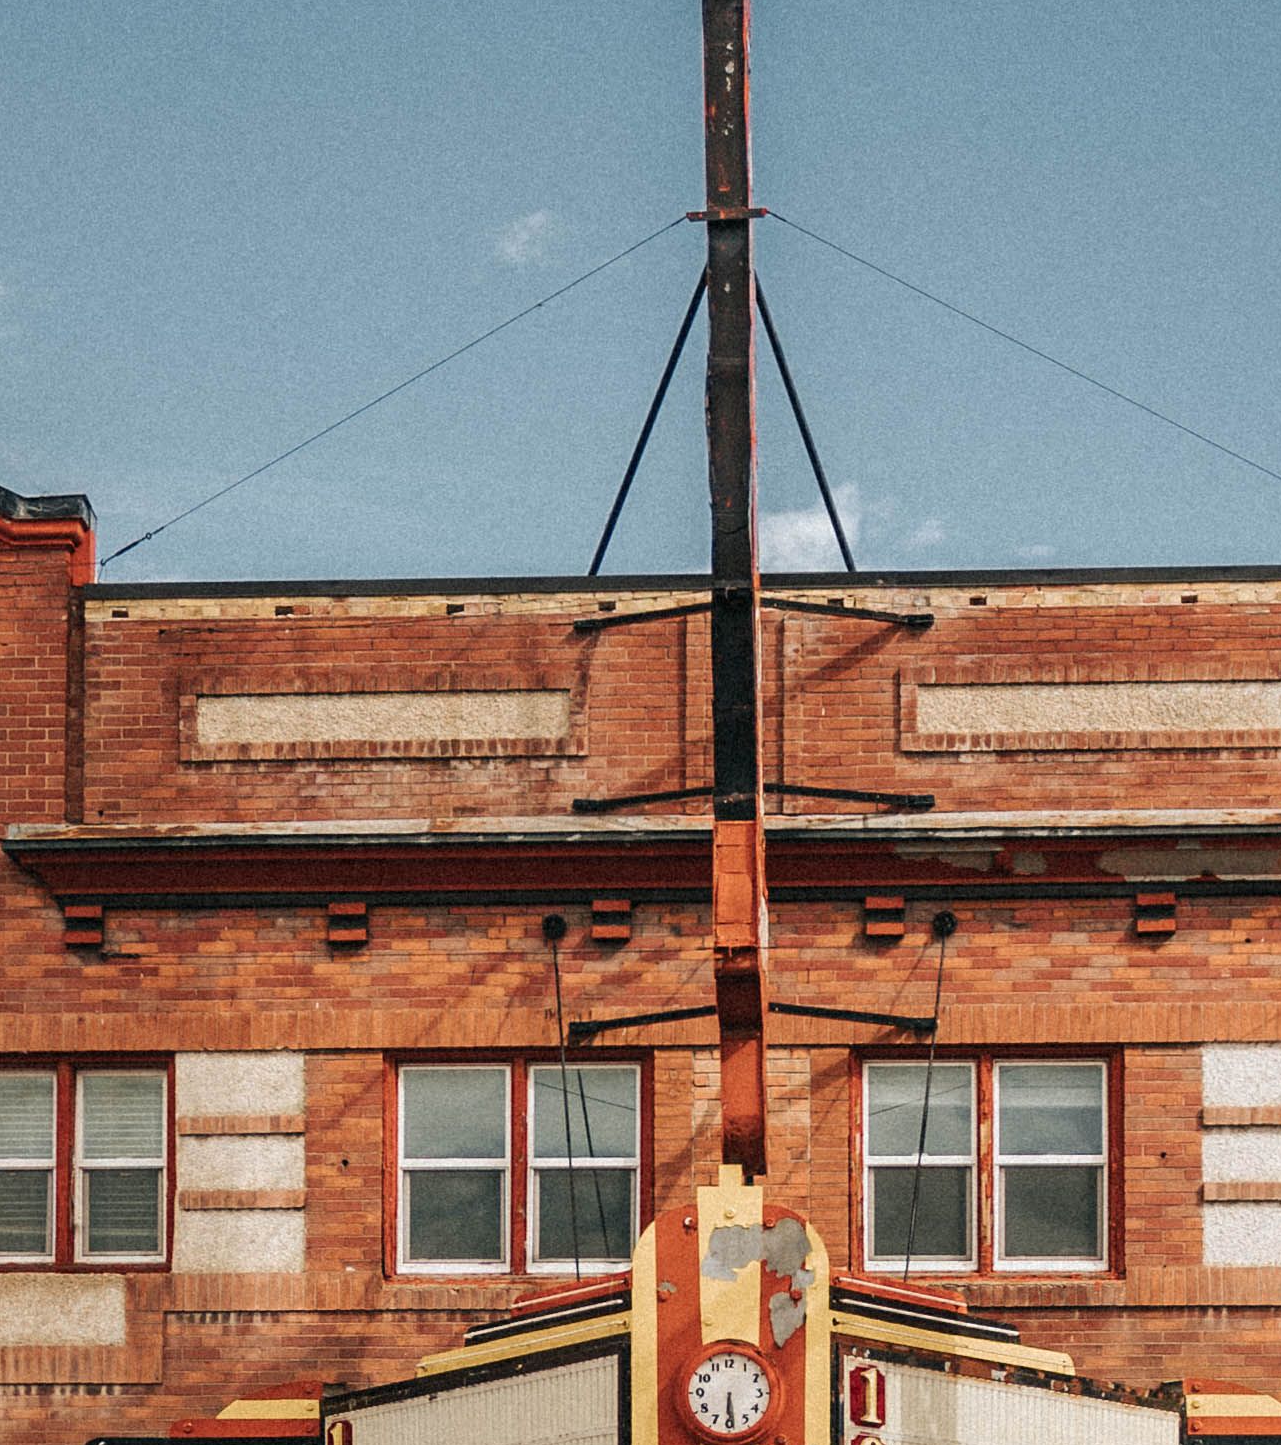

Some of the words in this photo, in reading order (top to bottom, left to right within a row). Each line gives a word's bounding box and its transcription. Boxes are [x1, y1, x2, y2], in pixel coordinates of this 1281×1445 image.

[711, 1362, 720, 1372] 11
[724, 1358, 735, 1369] 12
[698, 1373, 711, 1383] 10
[695, 1387, 705, 1398] 9
[755, 1388, 763, 1398] 3
[860, 1367, 883, 1424] 1
[700, 1402, 709, 1413] 8
[750, 1403, 759, 1414] 4
[711, 1414, 720, 1425] 7
[741, 1414, 749, 1425] 5
